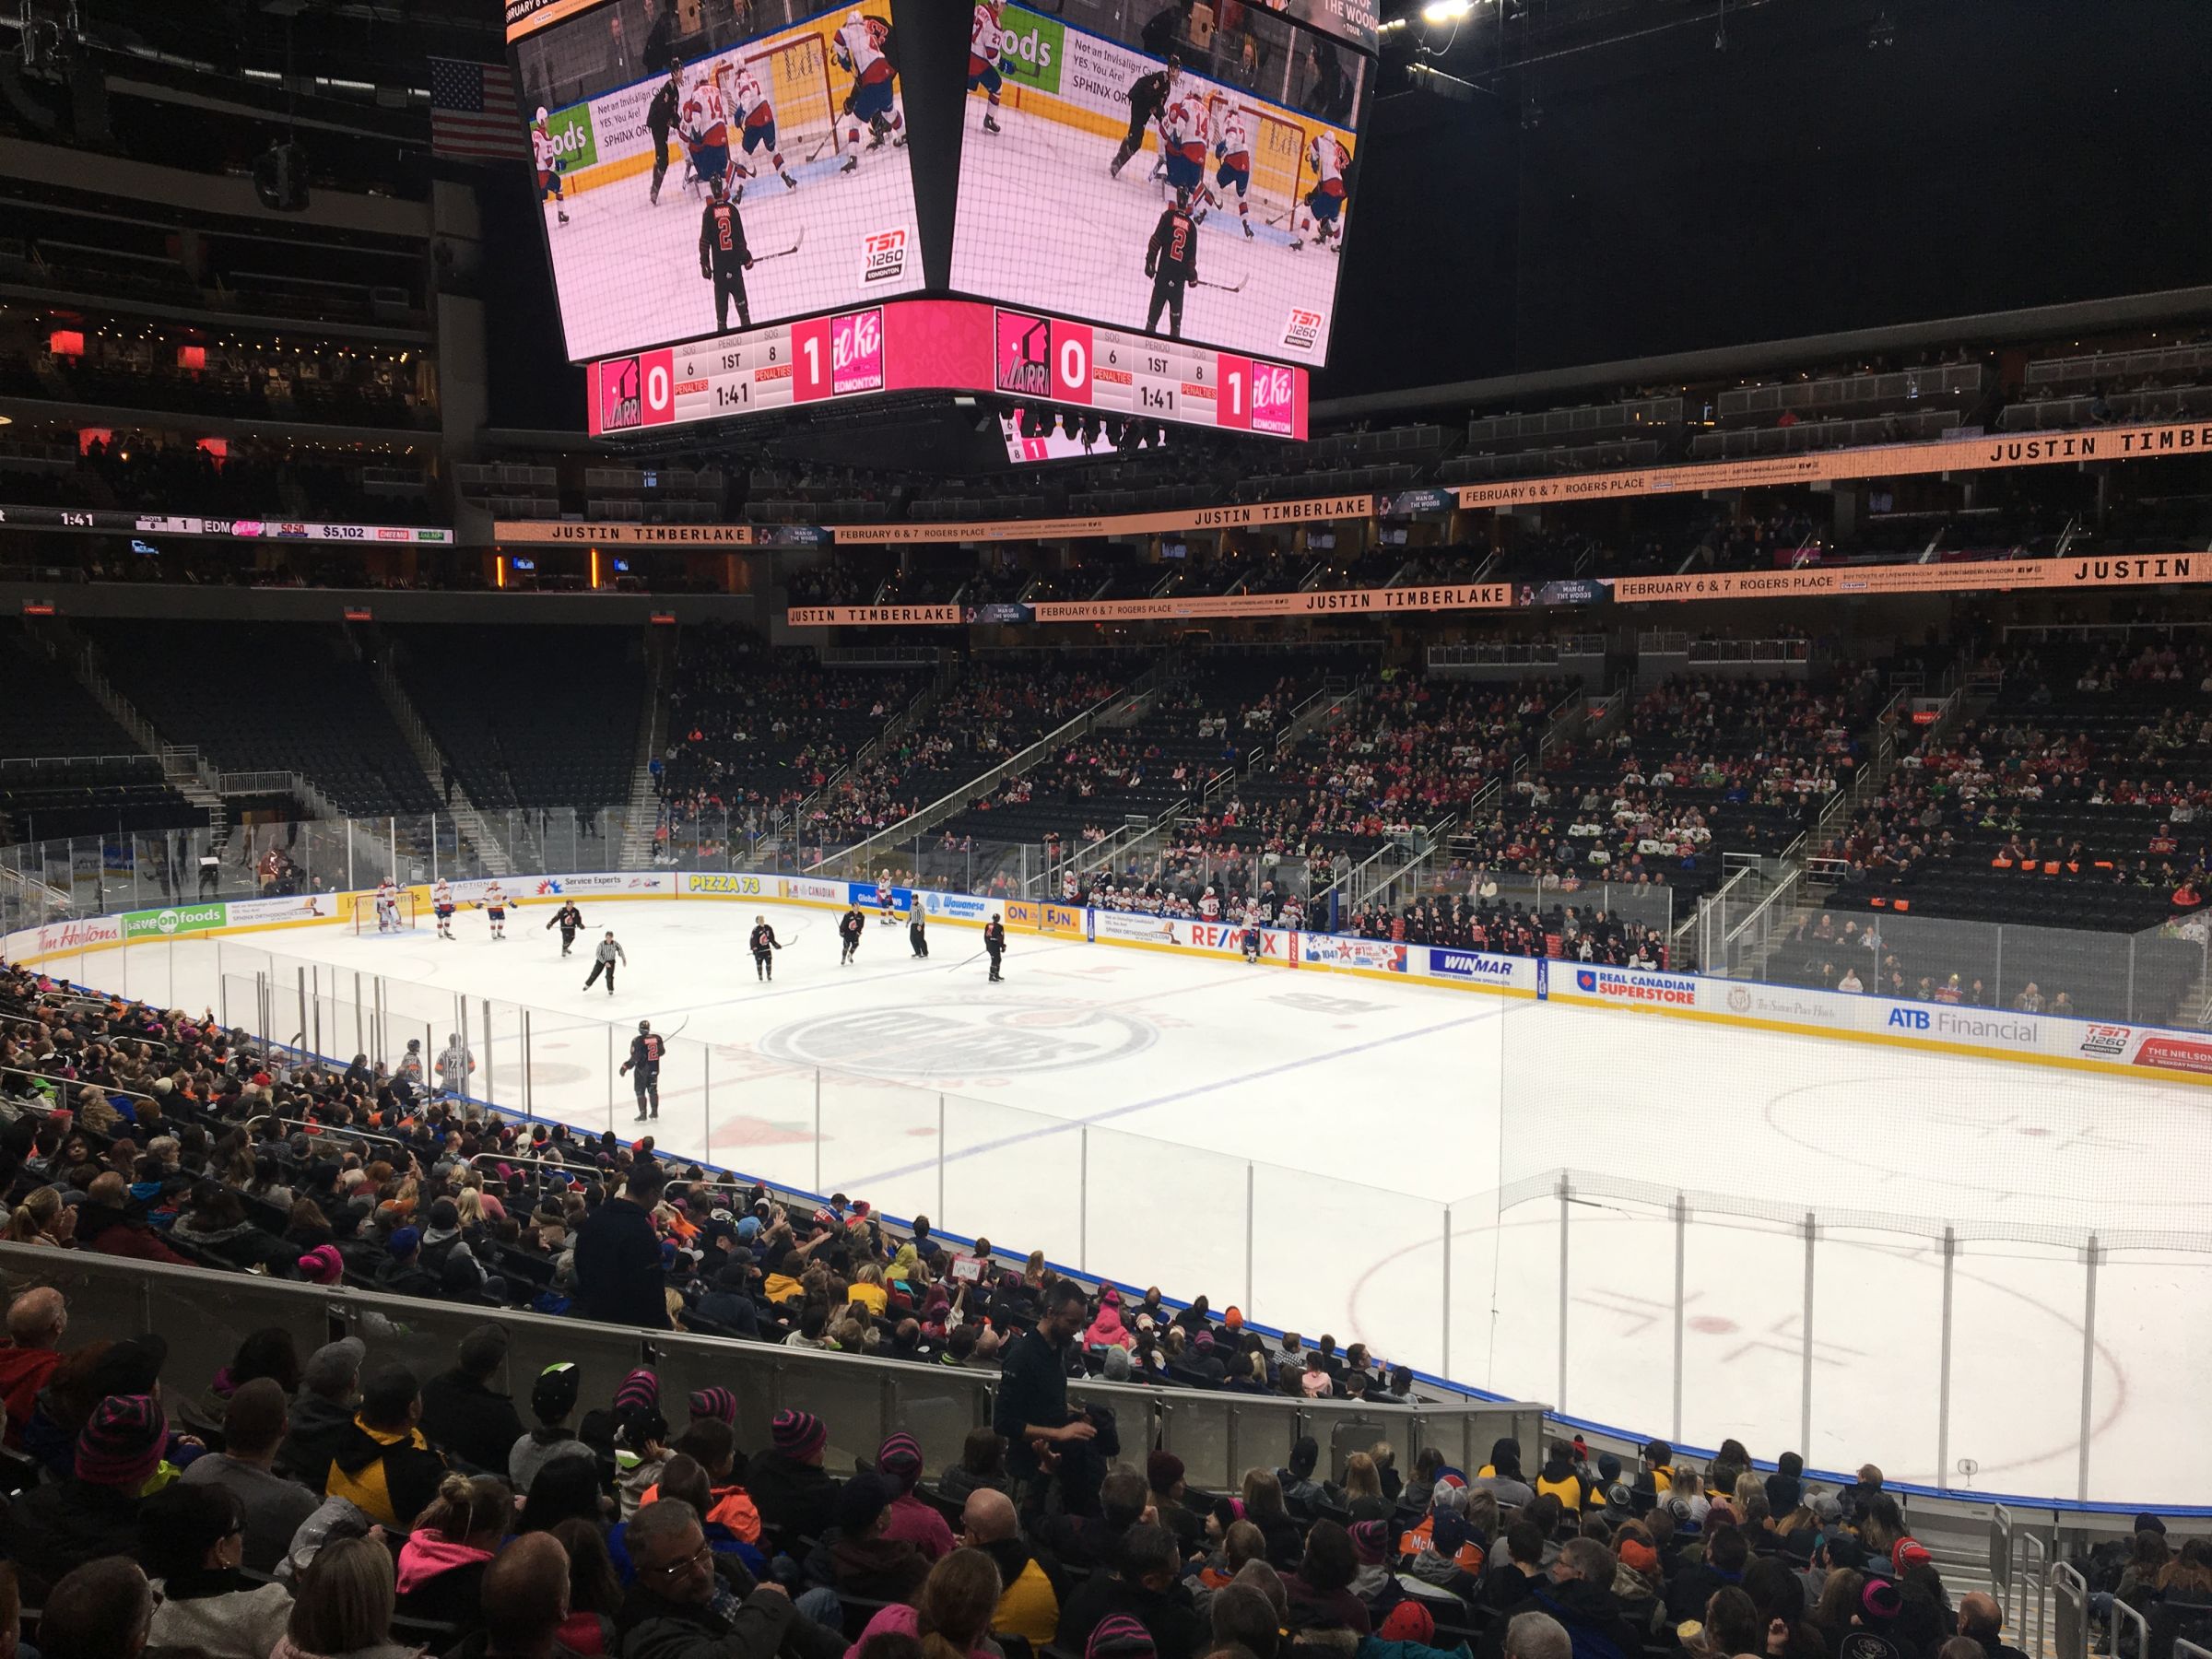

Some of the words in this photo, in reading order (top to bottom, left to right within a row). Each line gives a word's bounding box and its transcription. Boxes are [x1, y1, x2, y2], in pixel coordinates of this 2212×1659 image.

[1347, 24, 1359, 36] TOUR
[1076, 39, 1090, 53] Not
[1092, 47, 1102, 59] an
[1104, 51, 1142, 76] Invisalign
[1093, 63, 1107, 76] You
[1108, 66, 1125, 83] Are!
[1074, 76, 1111, 100] SPHINX
[598, 103, 610, 115] Not
[611, 102, 618, 111] an
[619, 91, 651, 109] Invisalign
[616, 112, 627, 123] You
[628, 109, 641, 121] Are!
[605, 126, 633, 147] SPHINX
[718, 218, 732, 251] 2
[865, 230, 904, 253] TSN
[1171, 228, 1186, 262] 2
[873, 249, 903, 266] 1260
[868, 267, 899, 279] EDMONTON
[1293, 310, 1321, 327] TSN
[1294, 325, 1316, 338] 1260
[683, 346, 696, 356] SOG
[718, 336, 742, 348] PERIOD
[764, 328, 779, 340] SOG
[1105, 332, 1120, 343] SOG
[1146, 340, 1170, 353] PERIOD
[1193, 349, 1206, 360] SOG
[687, 362, 694, 376] 6
[723, 354, 741, 370] 1ST
[769, 347, 776, 360] 8
[804, 337, 819, 385] 1
[1061, 339, 1086, 388] 0
[1109, 350, 1116, 364] 6
[1148, 357, 1168, 373] 1ST
[1196, 367, 1203, 380] 8
[756, 365, 792, 381] PENALTIES
[1094, 369, 1132, 383] PENALTIES
[648, 366, 668, 411] 0
[676, 380, 708, 394] PENALTIES
[834, 375, 881, 392] EDMONTON
[1182, 384, 1217, 399] PENALTIES
[716, 382, 748, 406] 1:41
[1141, 386, 1173, 410] 1:41
[1229, 371, 1241, 415] 1
[1253, 420, 1290, 433] EDMONTON
[1030, 441, 1039, 458] 1
[1991, 438, 2096, 462] JUSTIN
[1466, 488, 1524, 502] FEBRUARY
[1529, 486, 1535, 497] 6
[1540, 486, 1548, 497] &
[1552, 485, 1558, 495] 7
[1566, 482, 1607, 493] ROGERS
[1611, 478, 1644, 490] PLACE
[61, 512, 93, 526] 1:41
[1195, 510, 1250, 525] JUSTIN
[1264, 500, 1365, 520] TIMBERLAKE
[182, 520, 187, 530] 1
[206, 521, 230, 533] EDM
[324, 524, 364, 538] $5,102
[841, 529, 890, 539] FEBRUARY
[913, 529, 918, 537] 7
[924, 529, 958, 537] ROGERS
[960, 528, 984, 536] PLACE
[553, 527, 619, 539] JUSTIN
[635, 529, 745, 541] TIMBERLAKE
[2075, 558, 2190, 581] JUSTIN
[1622, 582, 1691, 595] FEBRUARY
[1697, 582, 1704, 592] 6
[1710, 581, 1719, 592] &
[1724, 580, 1731, 591] 7
[1740, 578, 1789, 590] ROGERS
[1794, 576, 1833, 588] PLACE
[1307, 594, 1370, 610] JUSTIN
[1384, 587, 1504, 606] TIMBERLAKE
[1569, 591, 1592, 599] WOODS
[791, 610, 835, 622] JUSTIN
[848, 607, 955, 621] TIMBERLAKE
[1041, 606, 1090, 616] FEBRUARY
[1092, 606, 1098, 615] 6
[1100, 606, 1106, 615] &
[1109, 606, 1113, 615] 7
[1118, 606, 1147, 614] ROGERS
[1148, 604, 1171, 613] PLACE
[565, 877, 592, 886] Service
[594, 876, 621, 887] Experts
[690, 875, 739, 892] PIZZA
[742, 877, 759, 894] 73
[809, 886, 835, 898] CANADIAN
[858, 893, 877, 903] Global
[944, 896, 984, 911] Wawanesa
[1208, 903, 1217, 912] 12
[127, 918, 157, 930] save
[159, 916, 177, 925] on
[181, 909, 220, 923] foods
[949, 909, 974, 918] Insurance
[1008, 906, 1027, 921] ON
[1048, 910, 1070, 925] FUN
[1445, 955, 1512, 975] WINMAR
[1600, 972, 1628, 984] REAL
[1631, 977, 1695, 992] CANADIAN
[1599, 982, 1695, 1006] SUPERSTORE
[1888, 1007, 1930, 1030] ATB
[1938, 1013, 2037, 1042] Financial
[2088, 1024, 2131, 1039] TSN
[2085, 1044, 2119, 1054] EDMONTON
[2090, 1035, 2126, 1046] 1260
[648, 1043, 659, 1061] 2
[2147, 1047, 2168, 1058] THE
